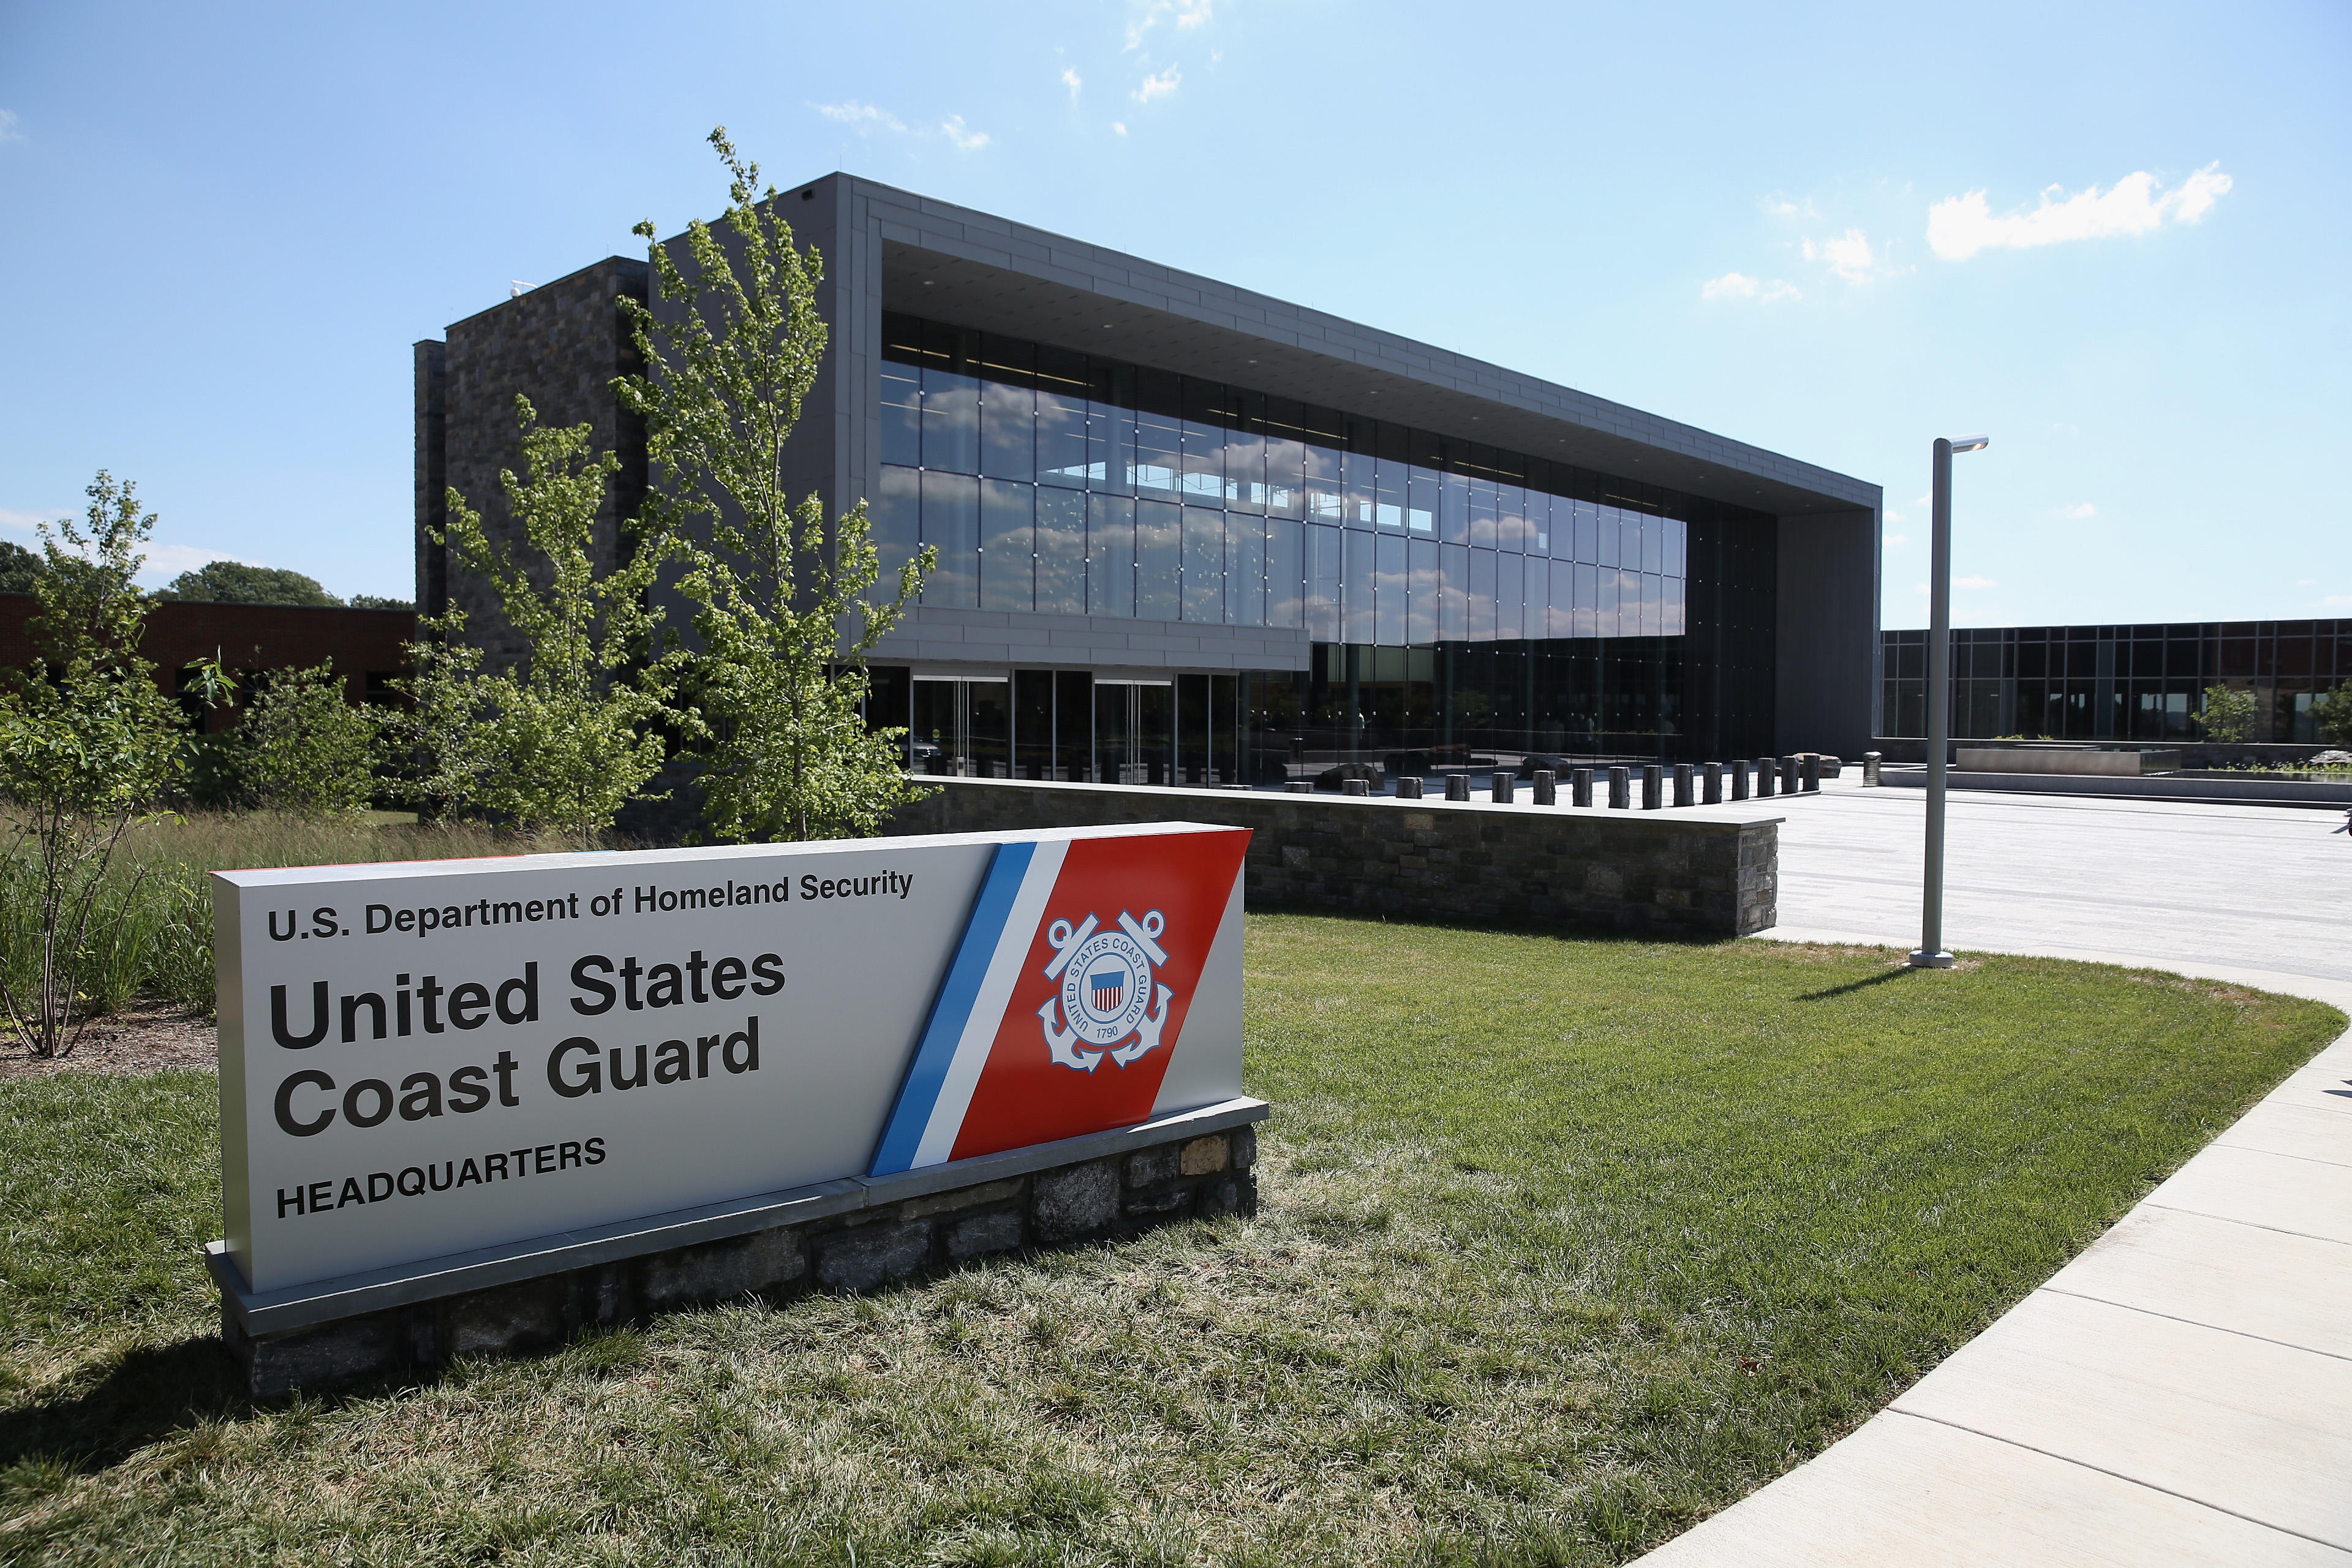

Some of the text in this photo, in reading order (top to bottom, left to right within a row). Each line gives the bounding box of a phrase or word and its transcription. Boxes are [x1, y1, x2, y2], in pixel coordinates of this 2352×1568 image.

[268, 870, 913, 941] U.S. Department of Homeland Security
[270, 950, 785, 1050] United States
[1067, 938, 1147, 1032] UNITED STATES COAST GUARD
[274, 1016, 760, 1137] Coast Guard
[1096, 1026, 1118, 1039] 1790
[276, 1137, 606, 1219] HEADQUARTERS
